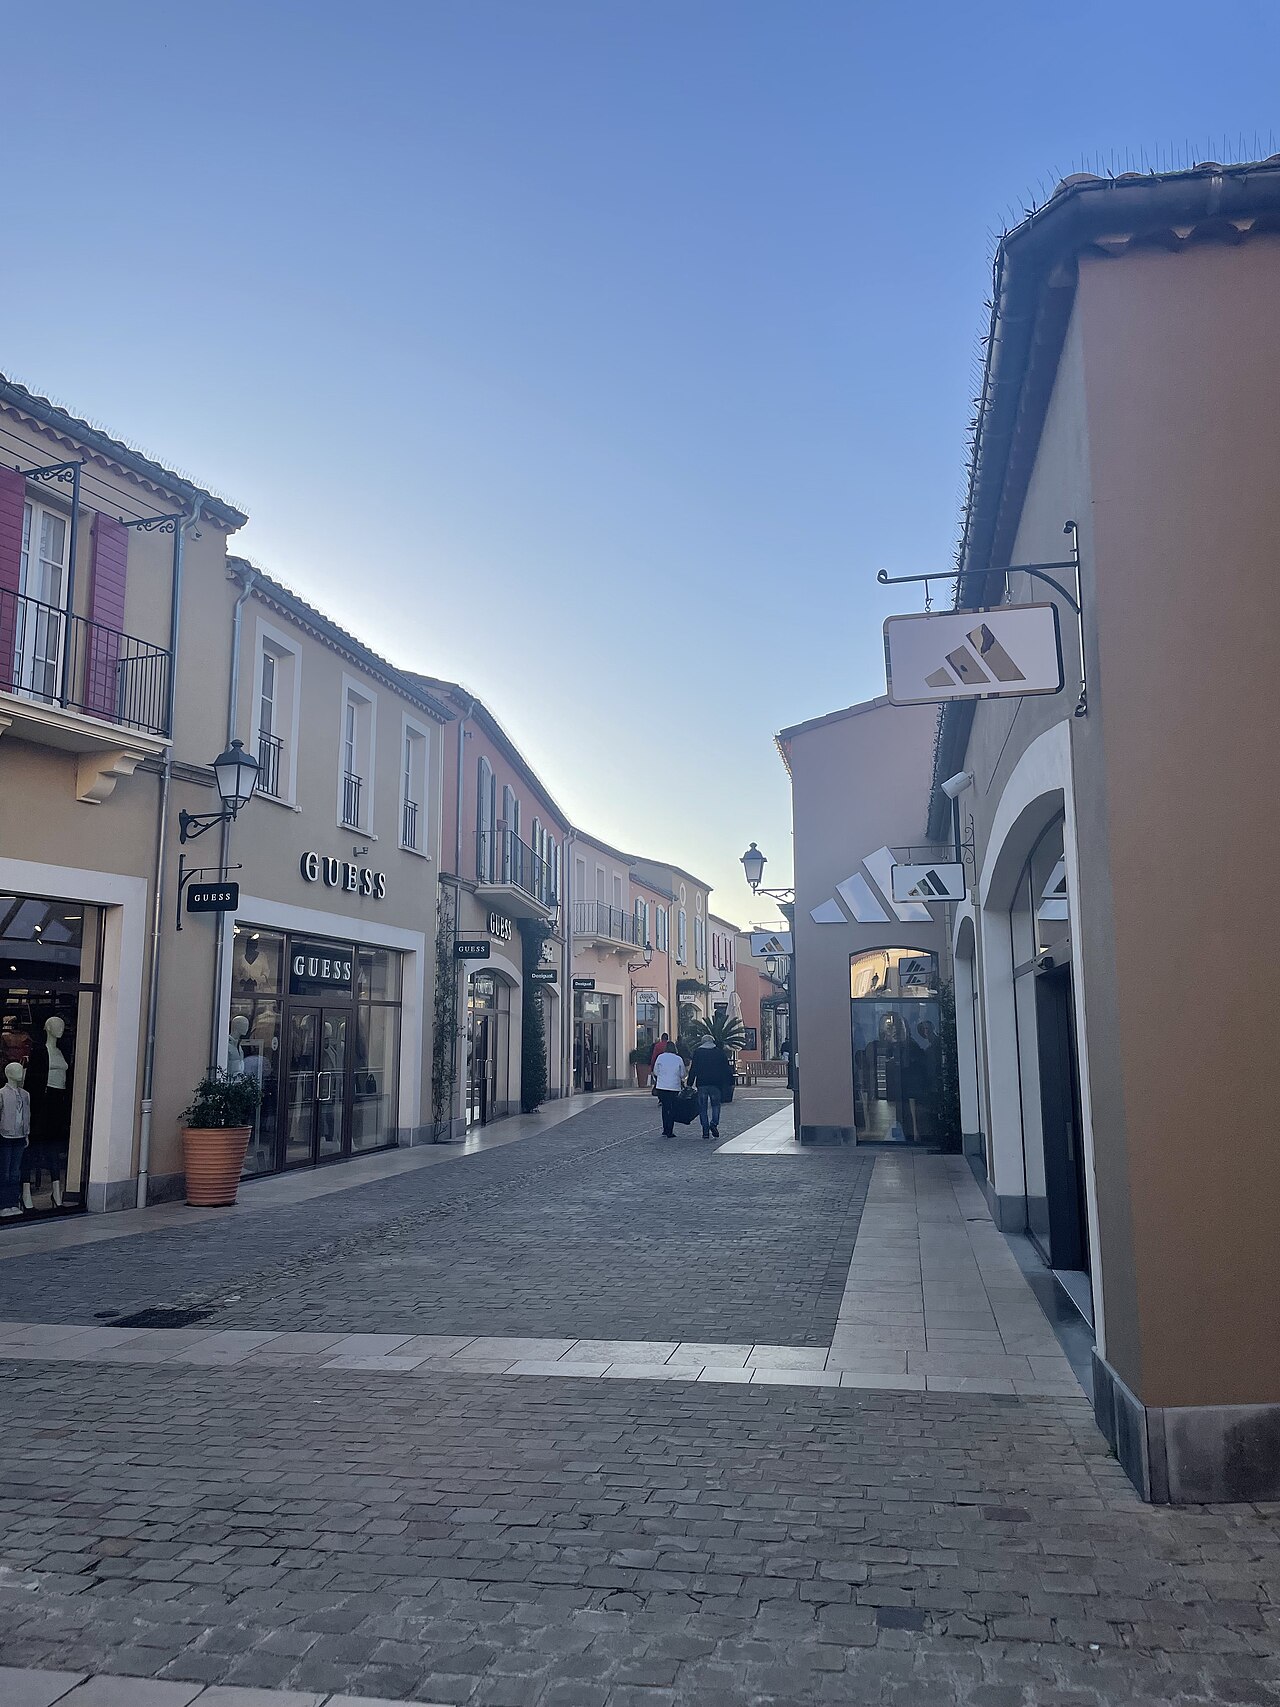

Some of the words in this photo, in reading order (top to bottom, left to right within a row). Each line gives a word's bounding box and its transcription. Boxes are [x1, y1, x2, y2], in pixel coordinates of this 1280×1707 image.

[300, 851, 386, 899] GUESS
[194, 892, 231, 902] GUESS
[490, 912, 512, 940] GUESS
[293, 955, 352, 981] GUESS
